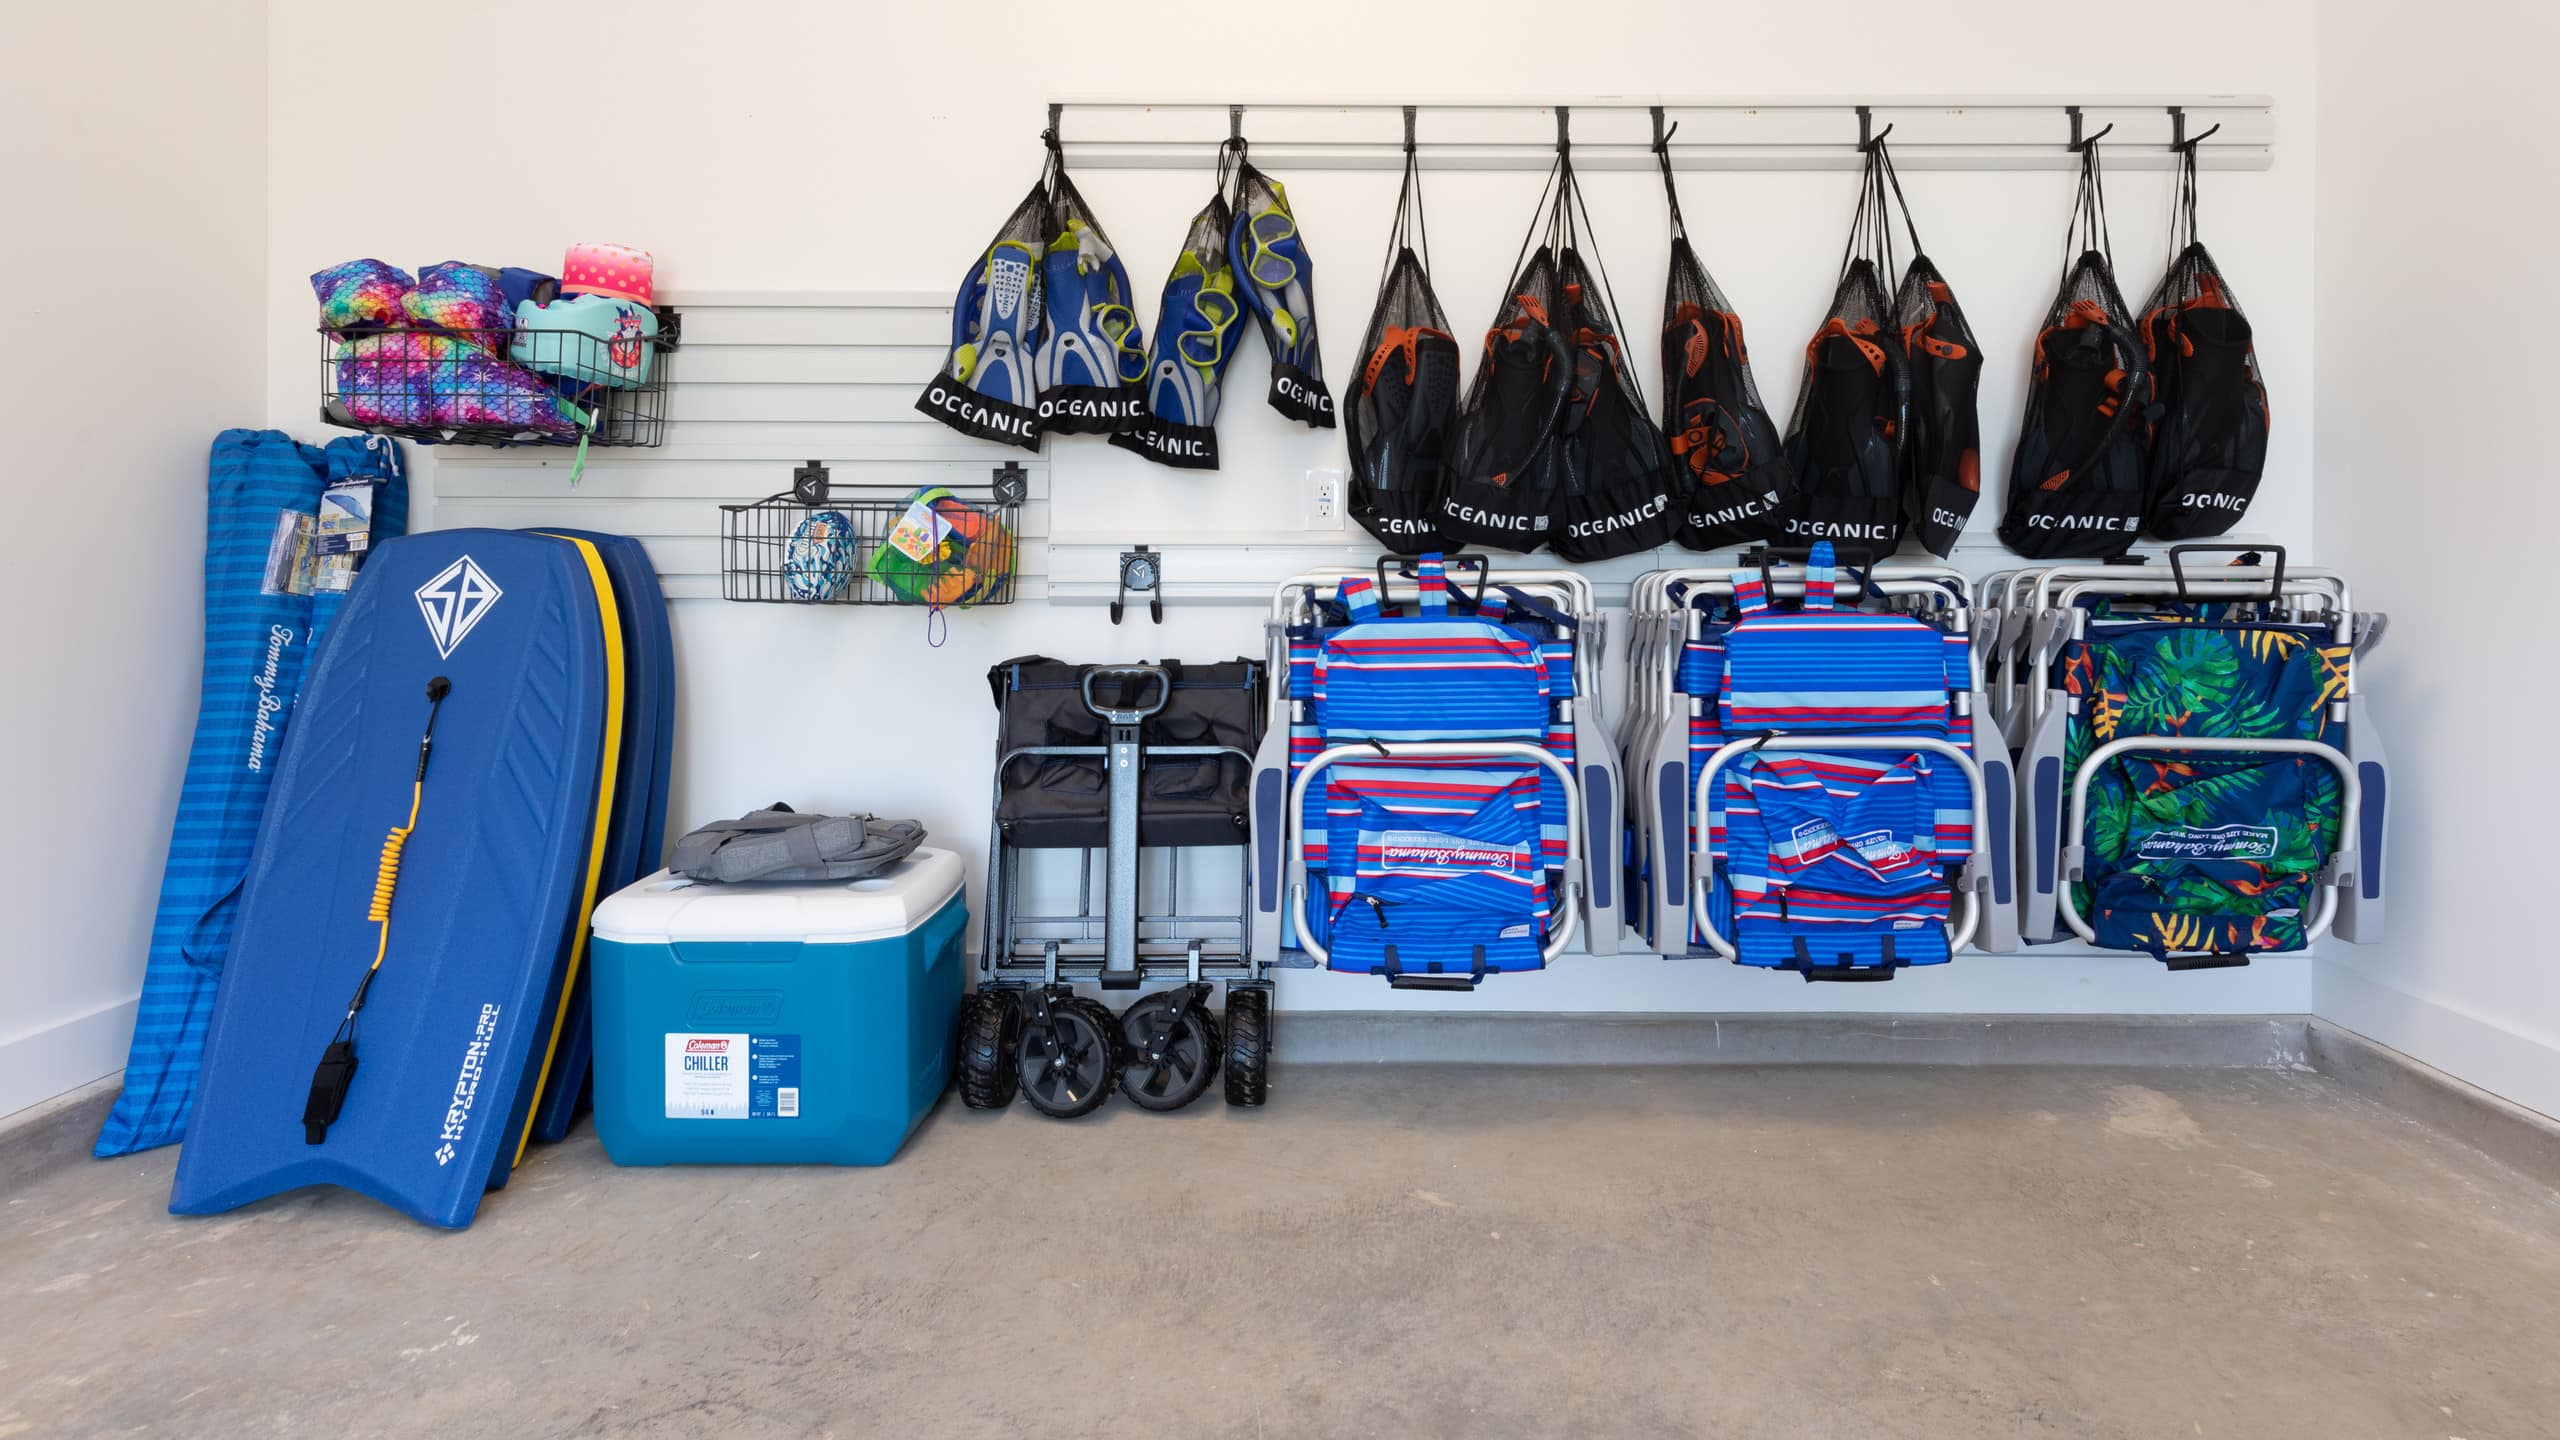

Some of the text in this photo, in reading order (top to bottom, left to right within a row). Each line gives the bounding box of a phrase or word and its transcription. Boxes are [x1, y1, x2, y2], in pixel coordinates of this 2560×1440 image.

[1001, 276, 1012, 314] OCEANIC
[929, 387, 1037, 439] OCEANIC
[1038, 399, 1145, 418] OCEANIC
[1120, 430, 1206, 456] EANIC
[1567, 502, 1656, 538] OCEANIC
[2028, 514, 2119, 531] OCANIC
[684, 1055, 729, 1071] CHILLER
